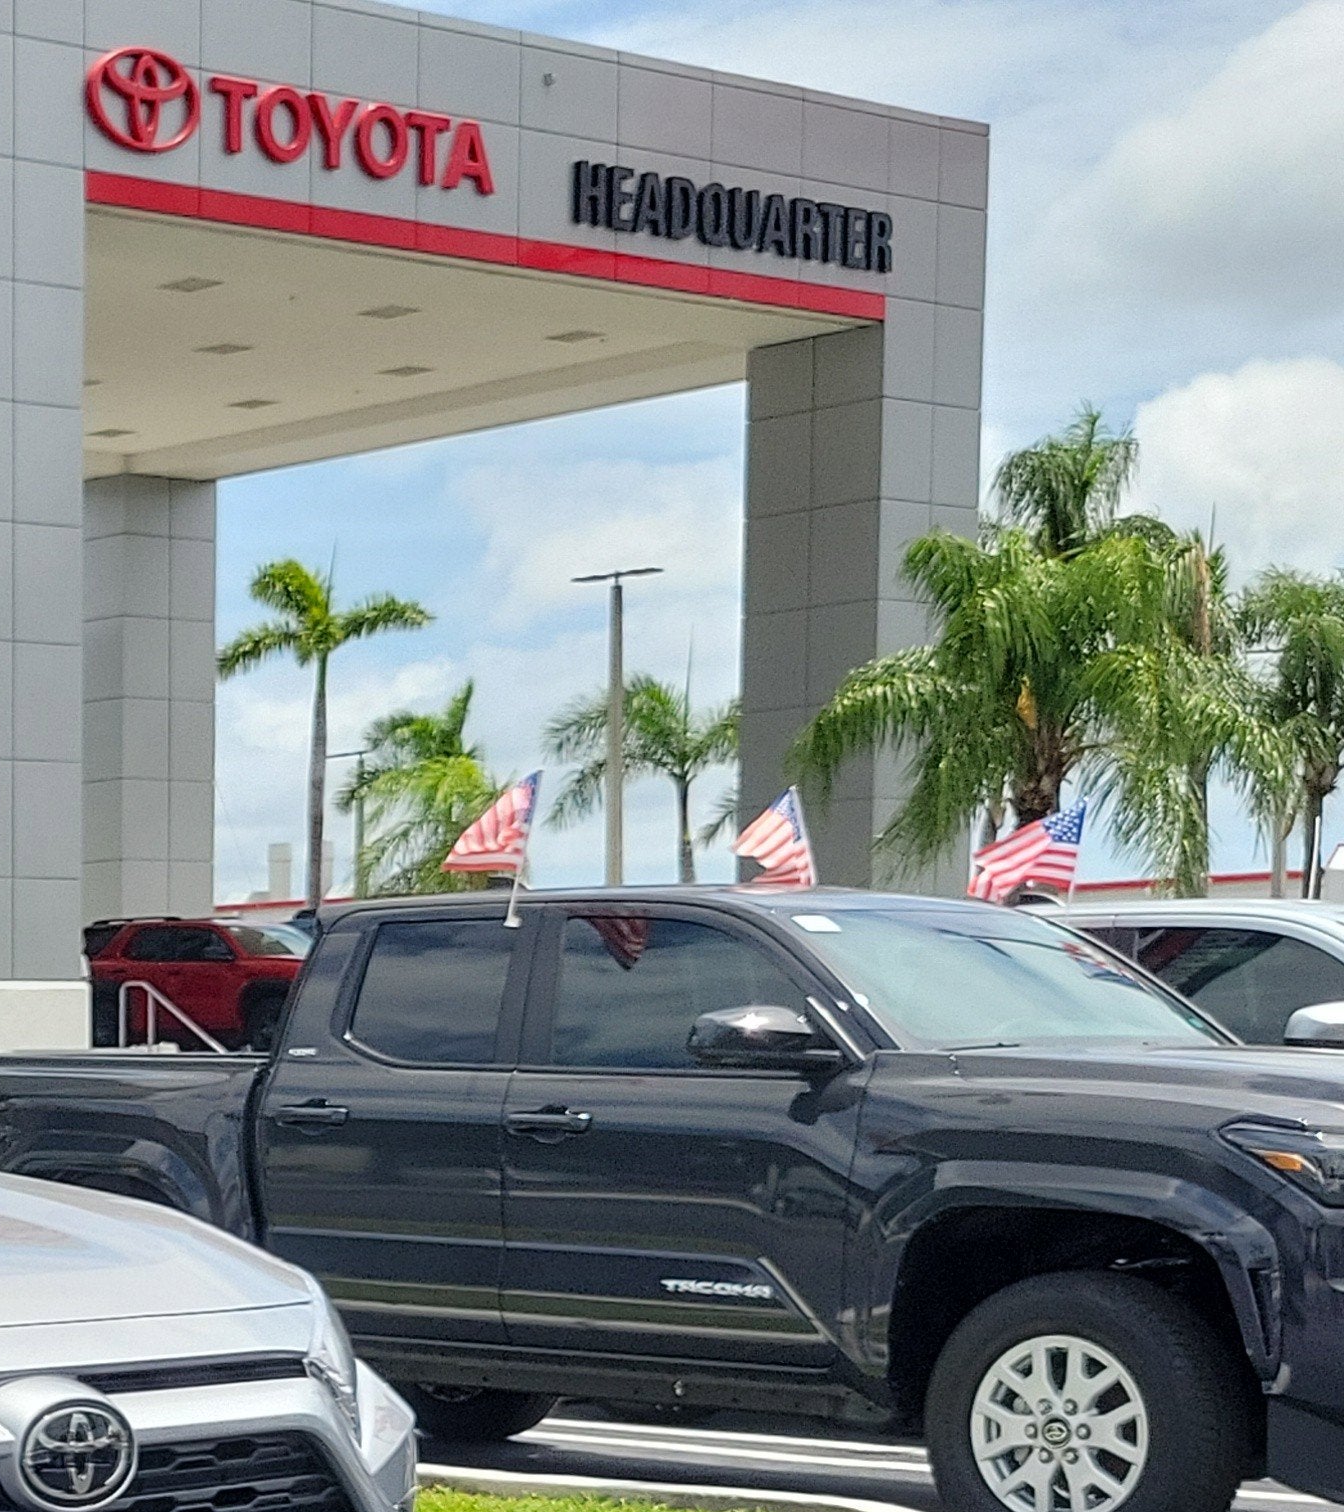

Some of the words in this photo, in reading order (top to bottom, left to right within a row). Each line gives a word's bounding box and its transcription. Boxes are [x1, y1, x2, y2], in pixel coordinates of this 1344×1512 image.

[208, 74, 494, 195] TOYOTA
[572, 160, 893, 273] HEADQUARTER
[659, 1278, 772, 1299] TACOMA
